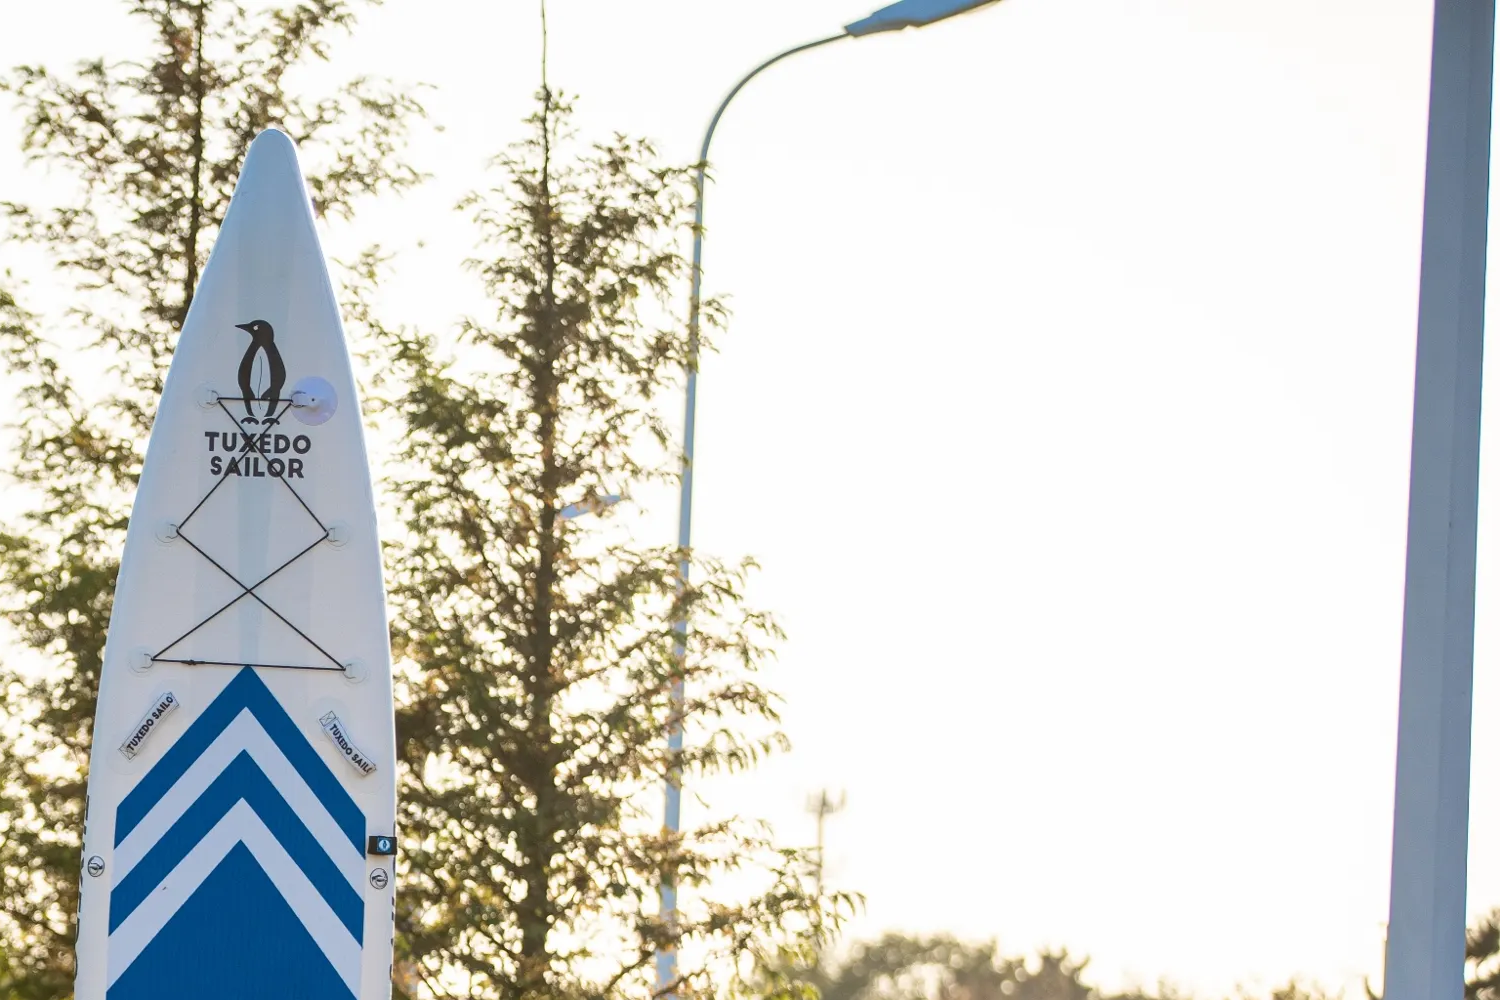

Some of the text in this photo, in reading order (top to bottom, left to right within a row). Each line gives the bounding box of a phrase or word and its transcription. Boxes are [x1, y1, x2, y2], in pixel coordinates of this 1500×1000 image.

[204, 431, 312, 455] TUXEDO
[209, 455, 305, 479] SAILOR
[126, 718, 154, 751] TUXEDO
[329, 723, 353, 755] TUXEDO
